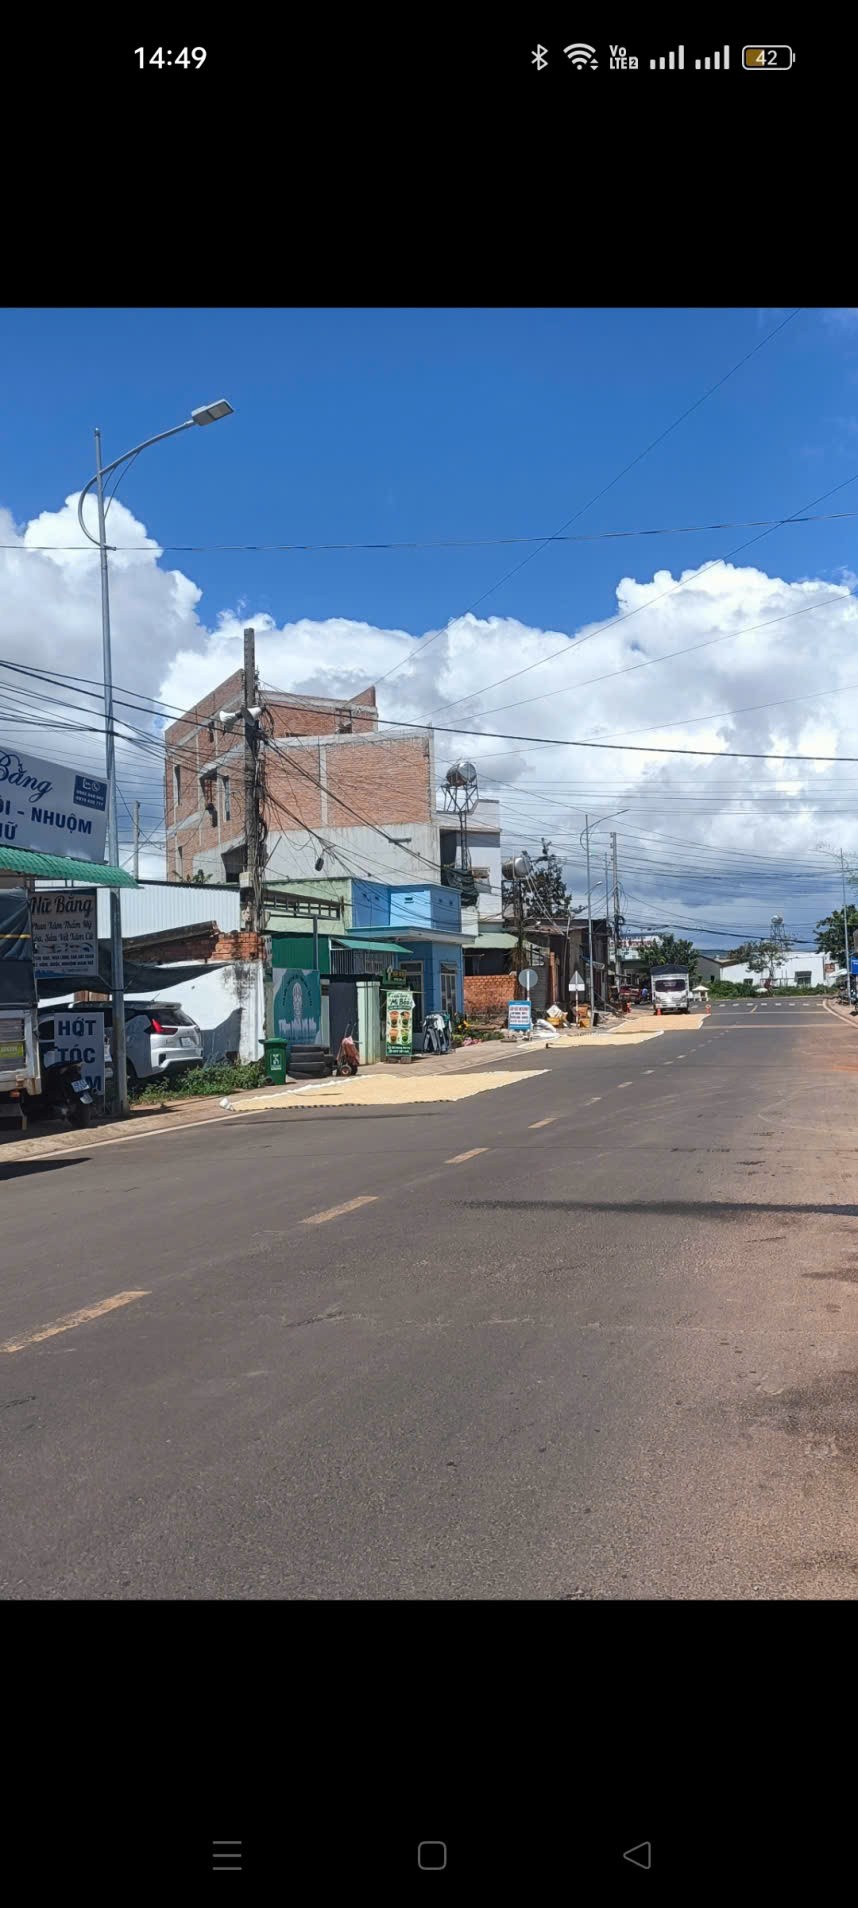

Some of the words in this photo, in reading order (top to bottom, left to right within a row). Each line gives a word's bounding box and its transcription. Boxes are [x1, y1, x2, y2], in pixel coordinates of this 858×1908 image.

[31, 806, 92, 834] NHUỘM
[58, 1017, 96, 1037] HỚT
[57, 1044, 95, 1064] TÓC
